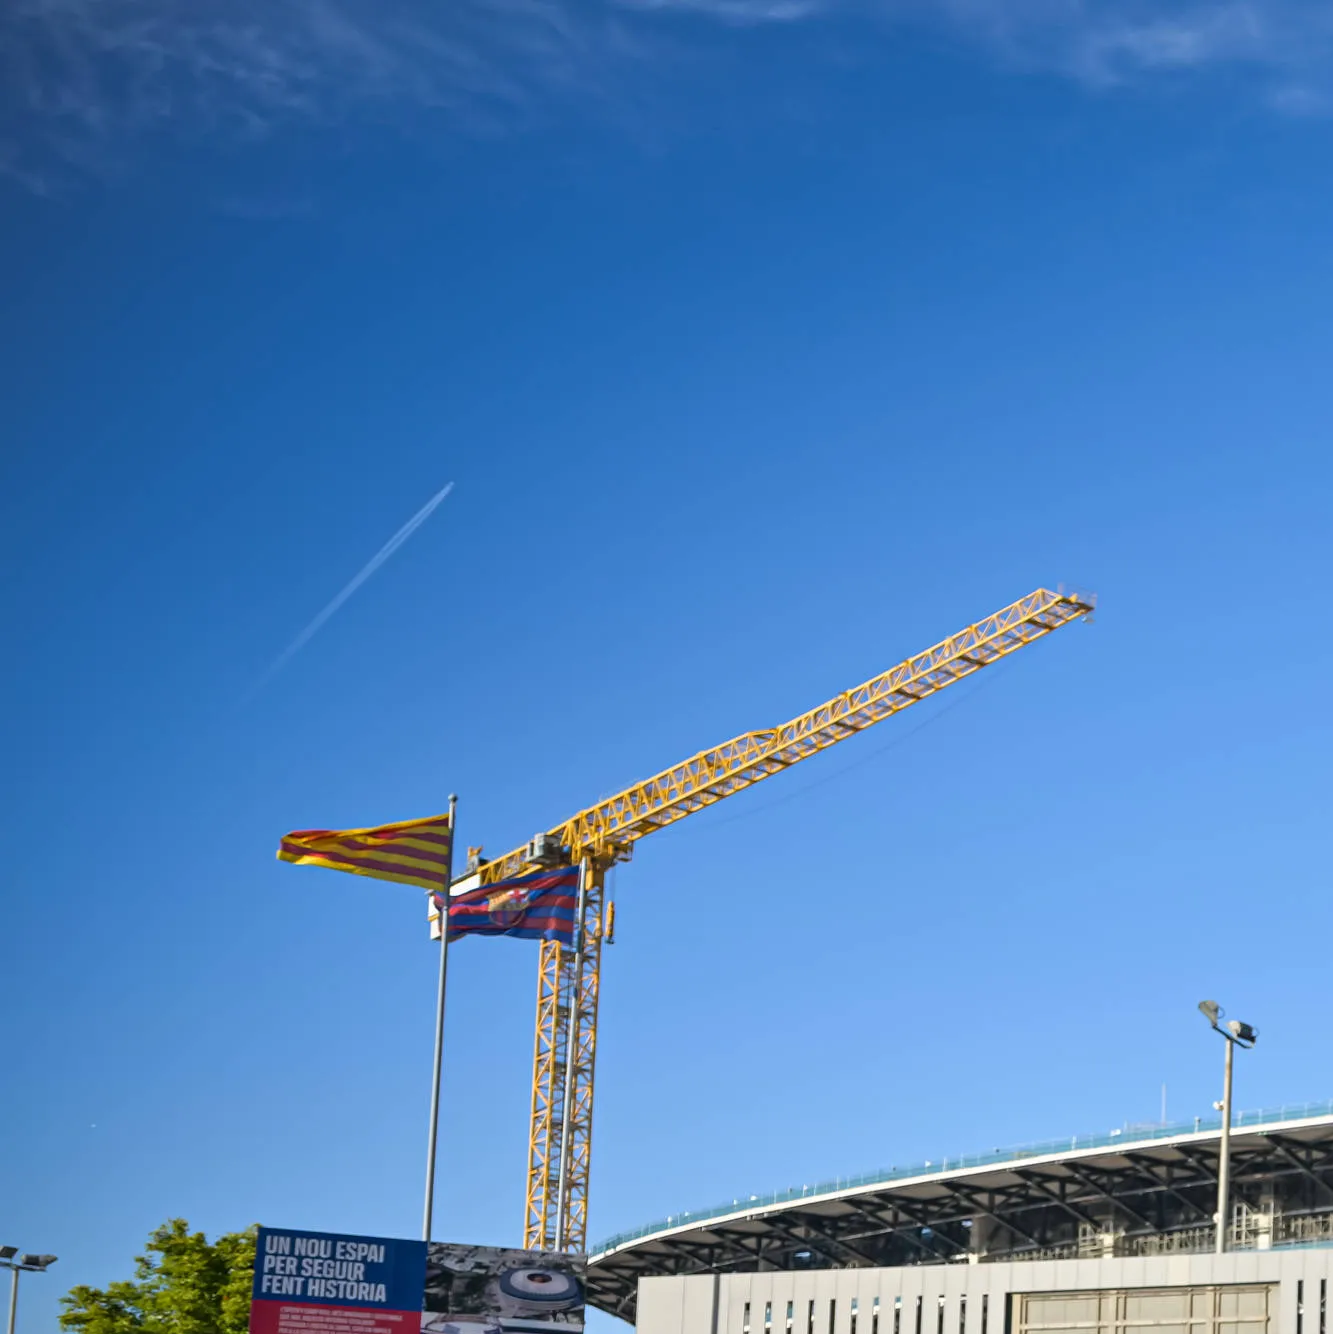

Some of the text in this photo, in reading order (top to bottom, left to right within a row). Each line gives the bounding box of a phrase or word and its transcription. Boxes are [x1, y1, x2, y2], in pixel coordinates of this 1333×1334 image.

[265, 1235, 385, 1263] UN NOU ESPAI
[263, 1255, 365, 1281] PER SEGUIR
[261, 1274, 305, 1296] FENT
